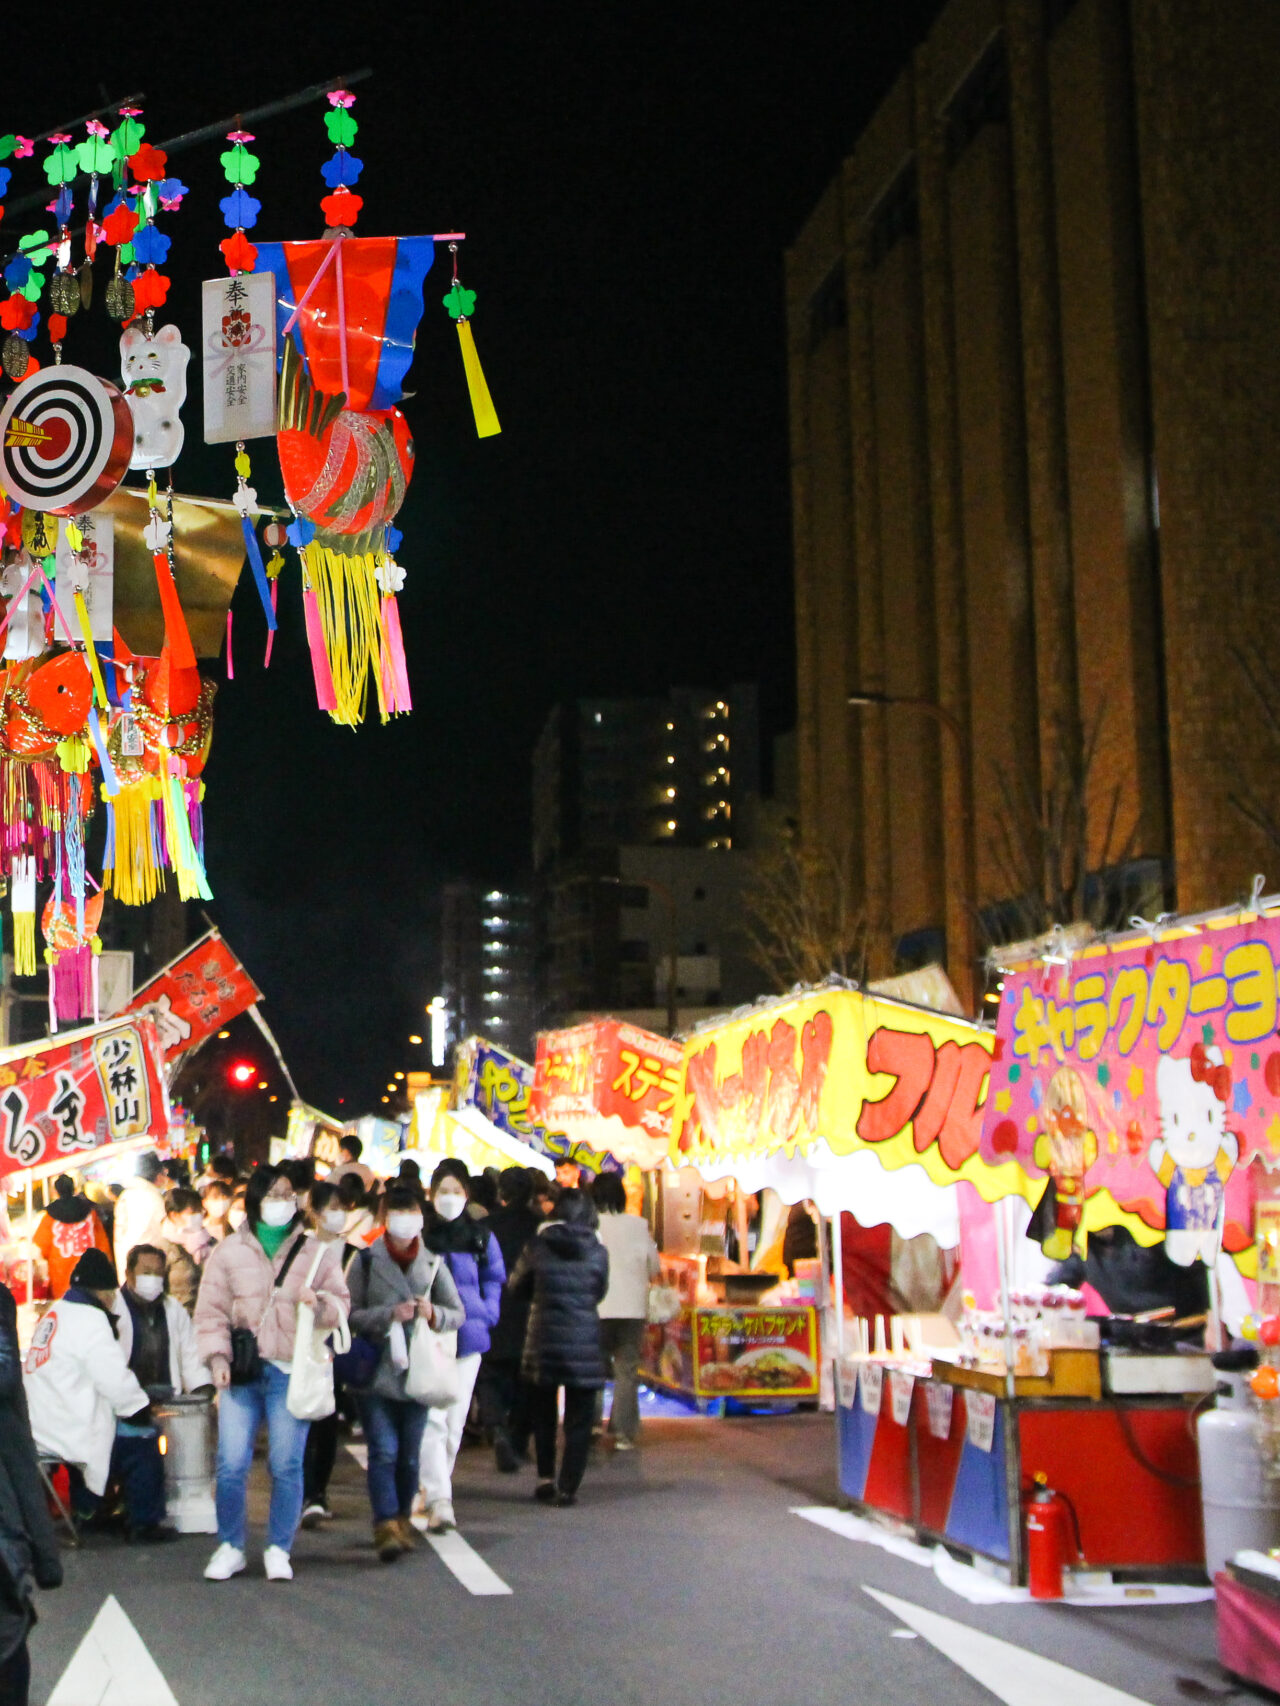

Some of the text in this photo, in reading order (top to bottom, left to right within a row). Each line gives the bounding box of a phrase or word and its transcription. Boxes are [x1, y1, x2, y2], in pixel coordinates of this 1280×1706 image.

[225, 364, 237, 408] 交通安全
[236, 362, 248, 406] 家内安全
[101, 1038, 139, 1126] 少林山
[52, 1211, 96, 1259] 福
